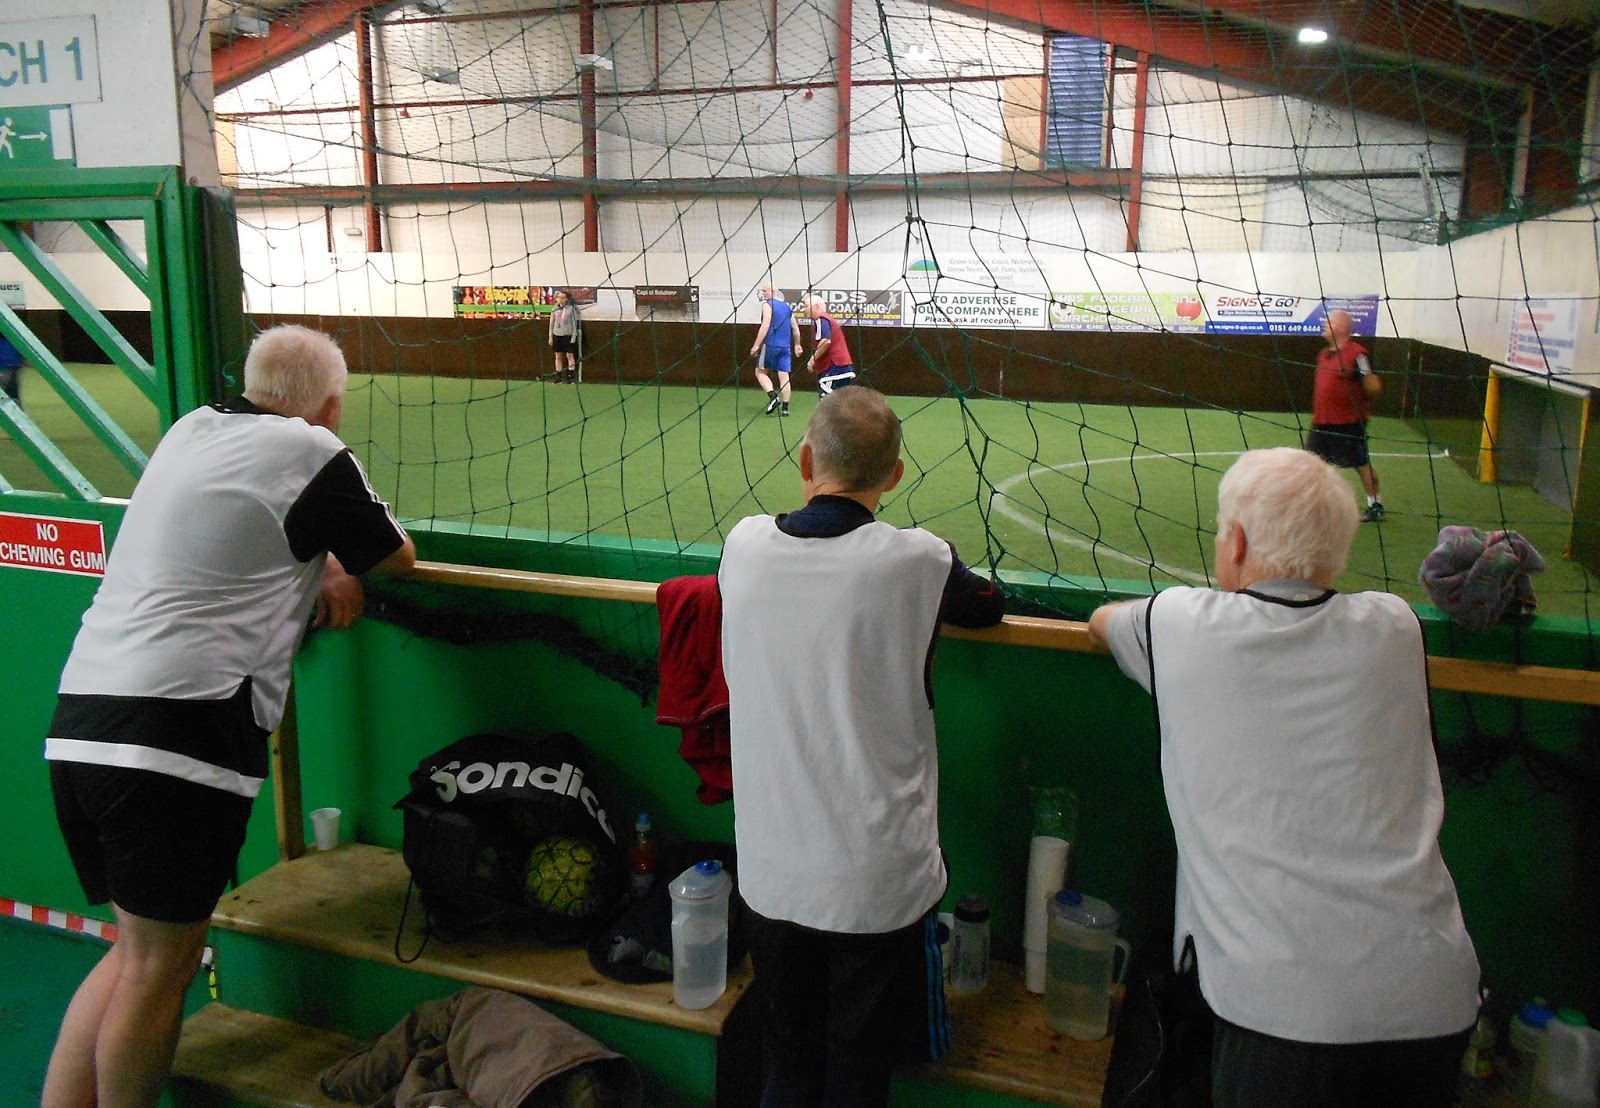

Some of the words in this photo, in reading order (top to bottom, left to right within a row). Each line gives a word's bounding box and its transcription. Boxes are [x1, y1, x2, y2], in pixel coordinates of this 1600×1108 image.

[65, 36, 83, 81] 1
[933, 295, 948, 304] TO
[952, 296, 1017, 305] ADVERTISE
[1054, 294, 1085, 303] KIDS
[1217, 296, 1258, 307] SIGNS
[1262, 297, 1273, 307] 2
[1275, 297, 1301, 307] GO!
[911, 306, 943, 315] YOUR
[946, 306, 1004, 315] COMPANY
[1008, 307, 1039, 316] HERE
[980, 317, 1022, 325] reception.
[1269, 324, 1287, 332] 0151
[36, 522, 58, 542] NO
[0, 542, 65, 566] CHEWING
[70, 549, 104, 570] GUM
